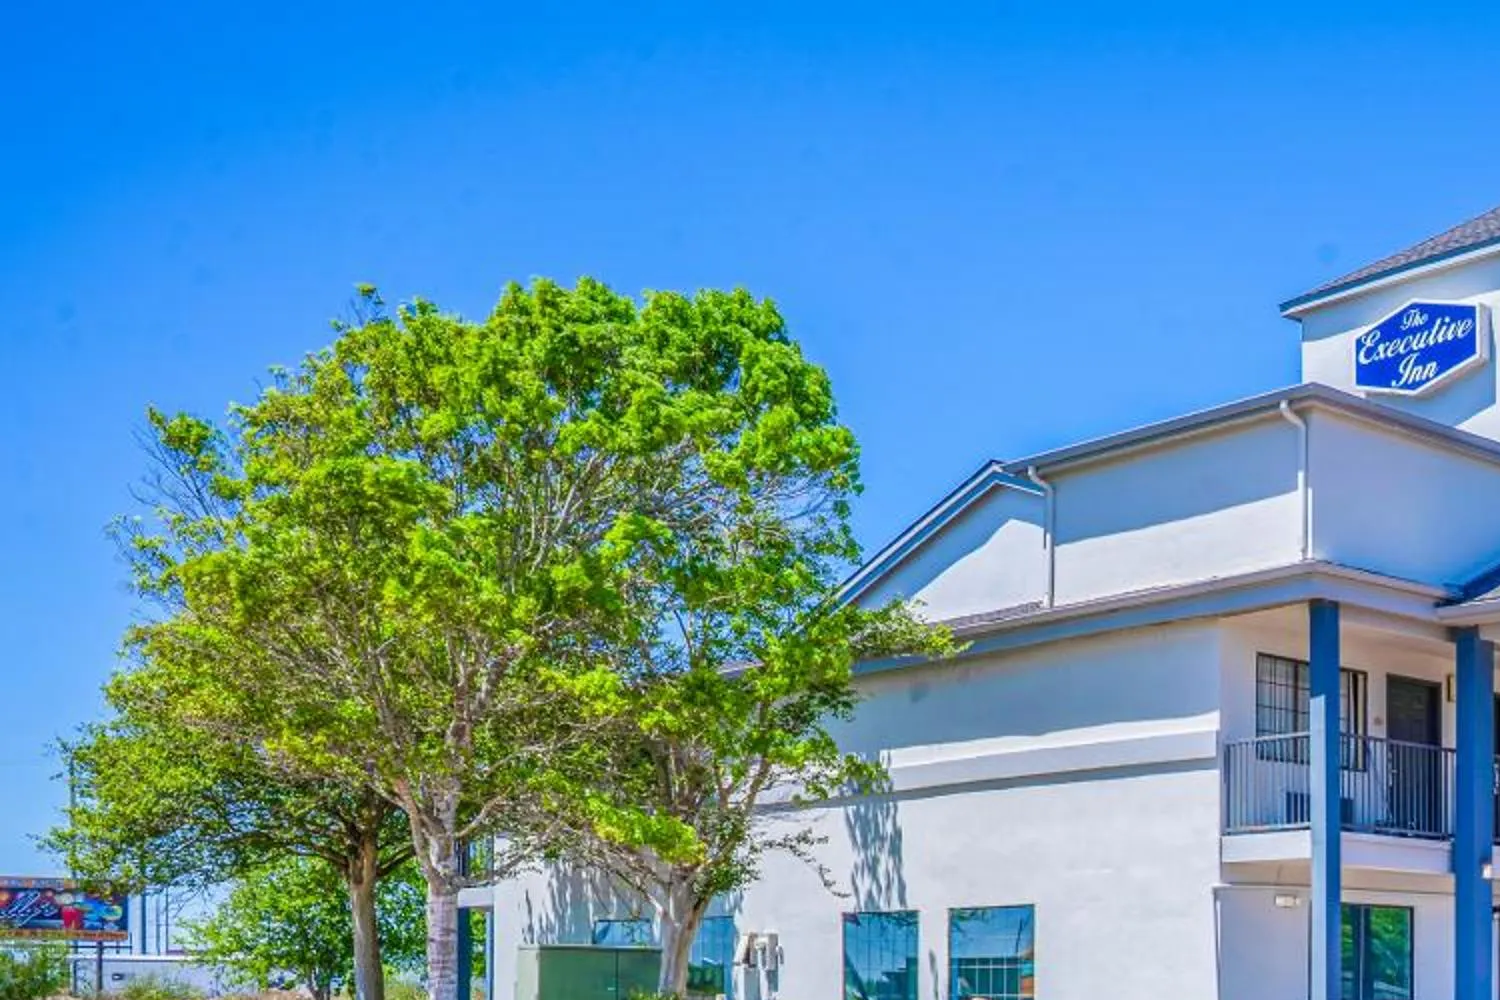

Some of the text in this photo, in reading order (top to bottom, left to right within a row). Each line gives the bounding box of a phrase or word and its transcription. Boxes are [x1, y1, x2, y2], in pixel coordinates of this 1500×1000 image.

[1400, 308, 1429, 331] The
[1358, 316, 1474, 365] Executive
[1391, 352, 1439, 387] Inn
